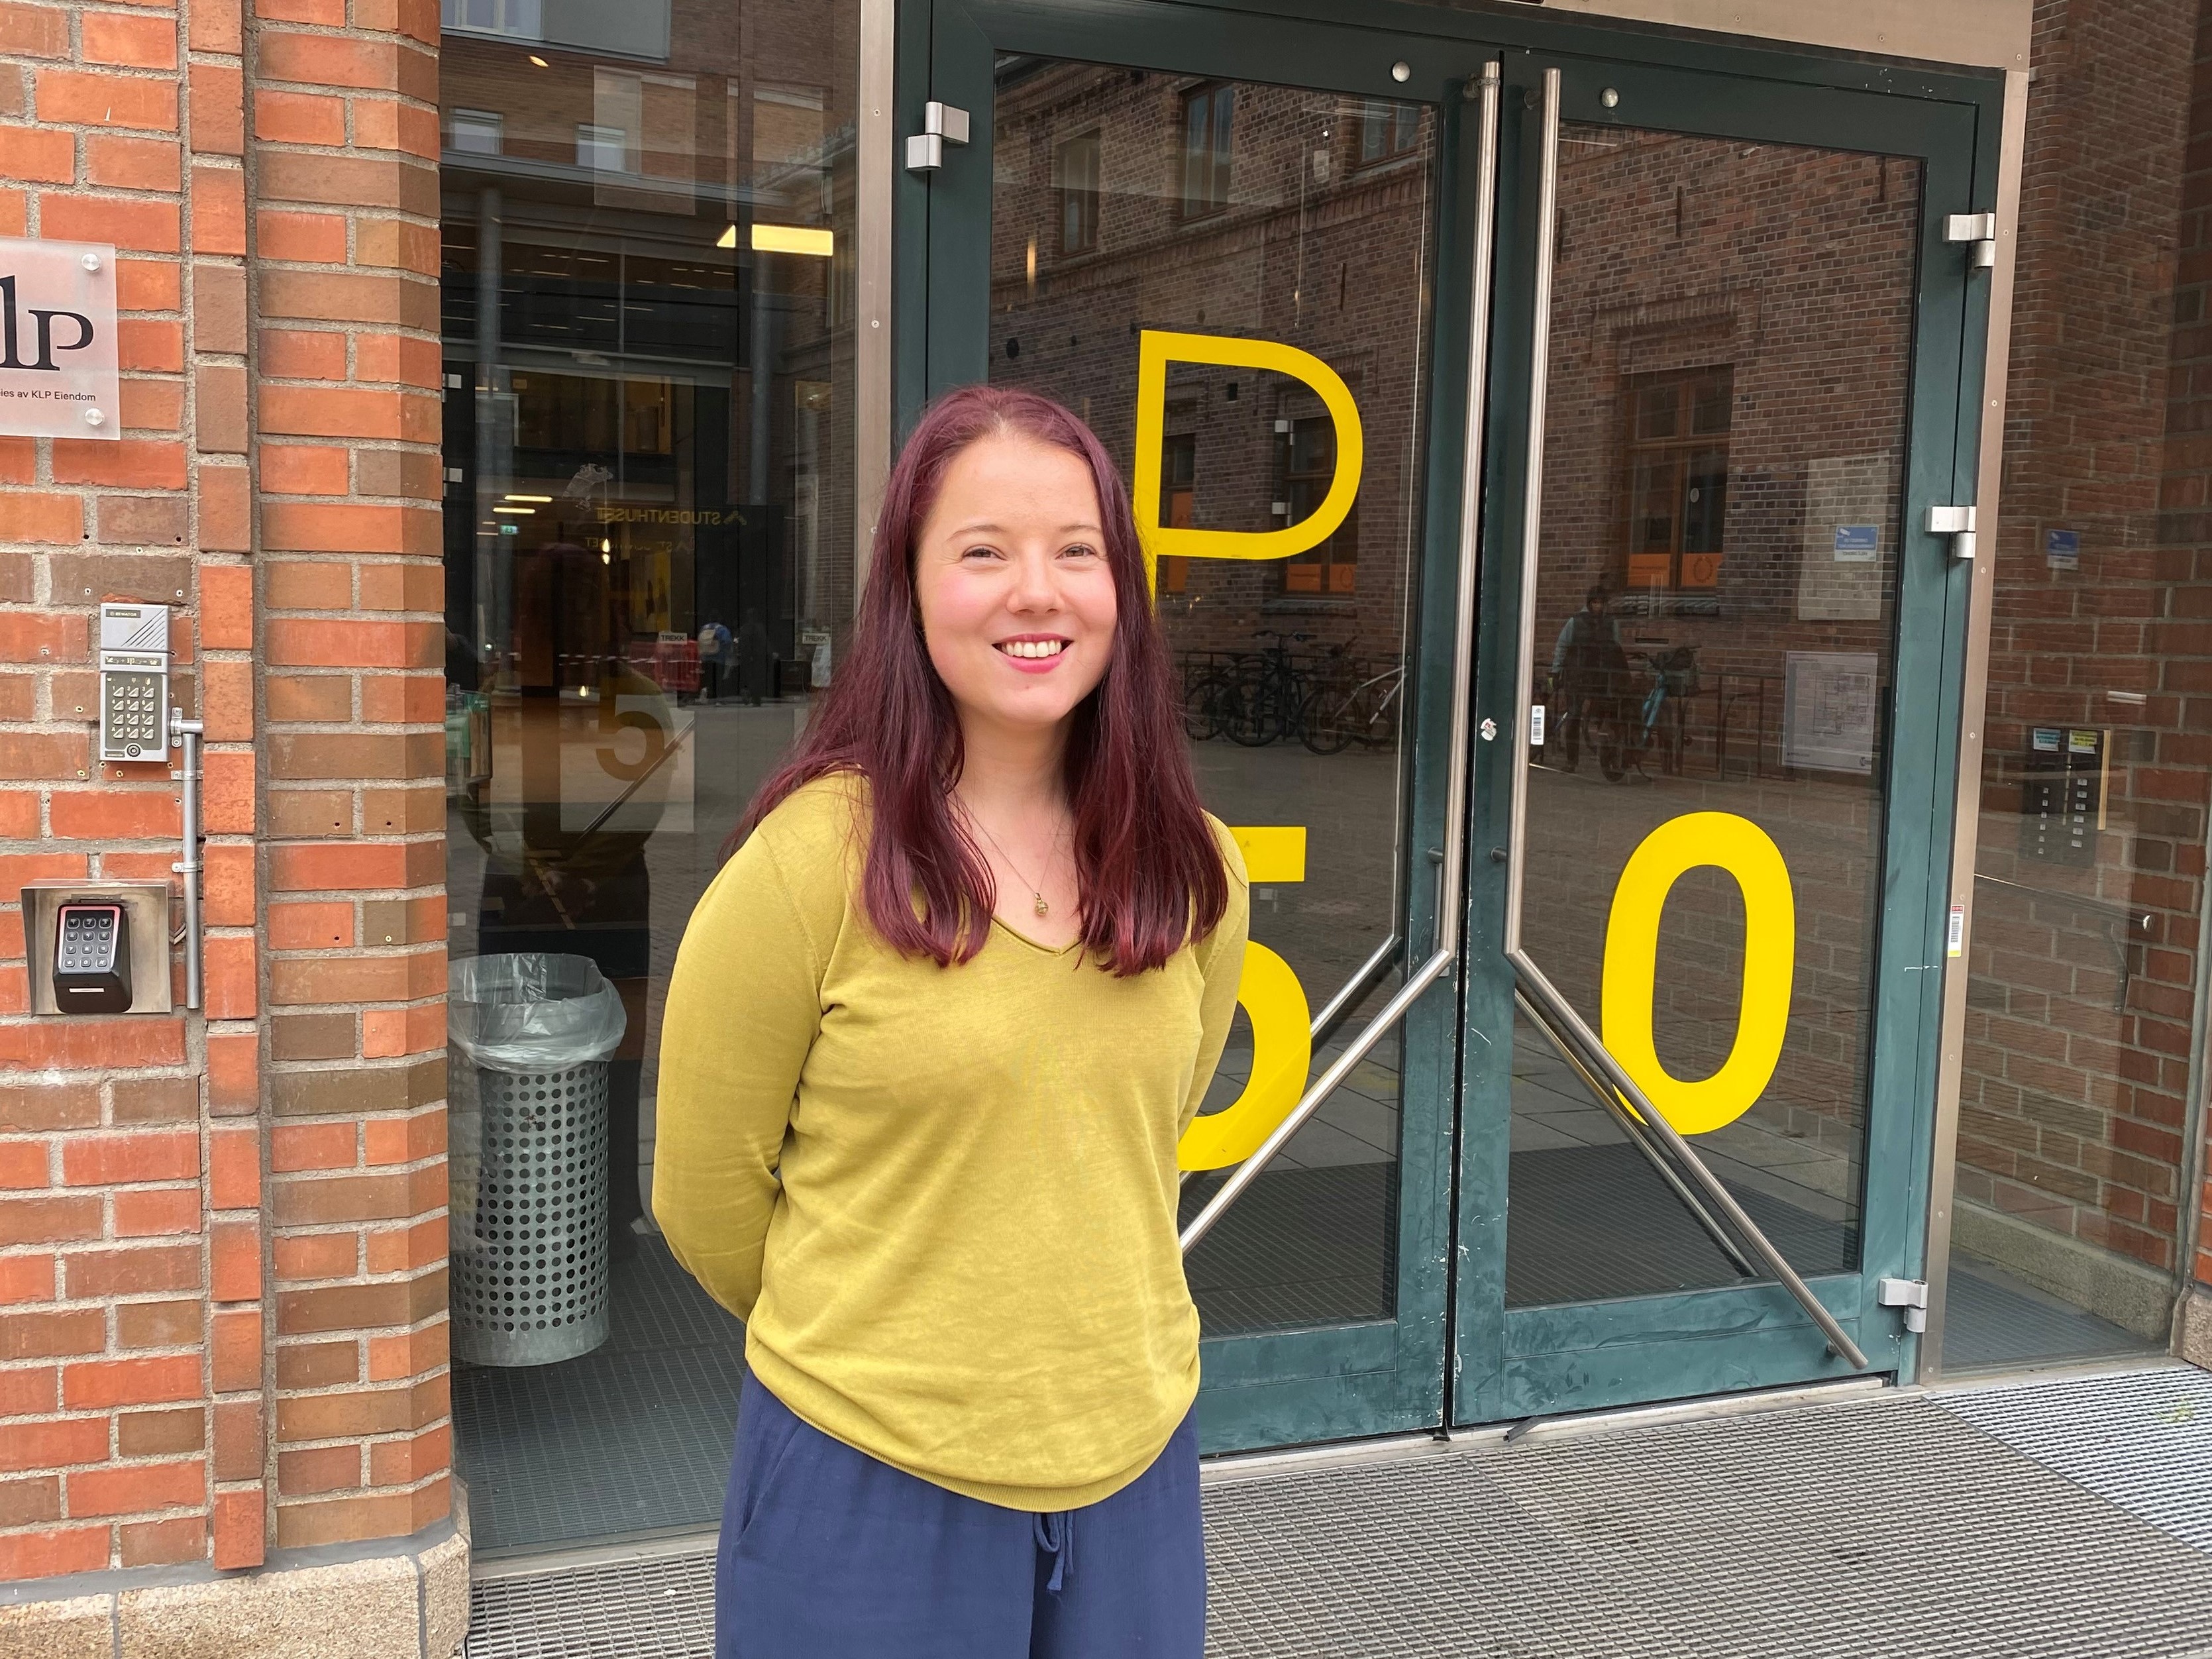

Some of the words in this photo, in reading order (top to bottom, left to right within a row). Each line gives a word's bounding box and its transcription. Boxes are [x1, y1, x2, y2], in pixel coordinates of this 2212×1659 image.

[32, 390, 51, 399] KLP
[54, 392, 96, 401] Eiendom
[1133, 330, 1363, 616] P
[1601, 812, 1795, 1134] 0
